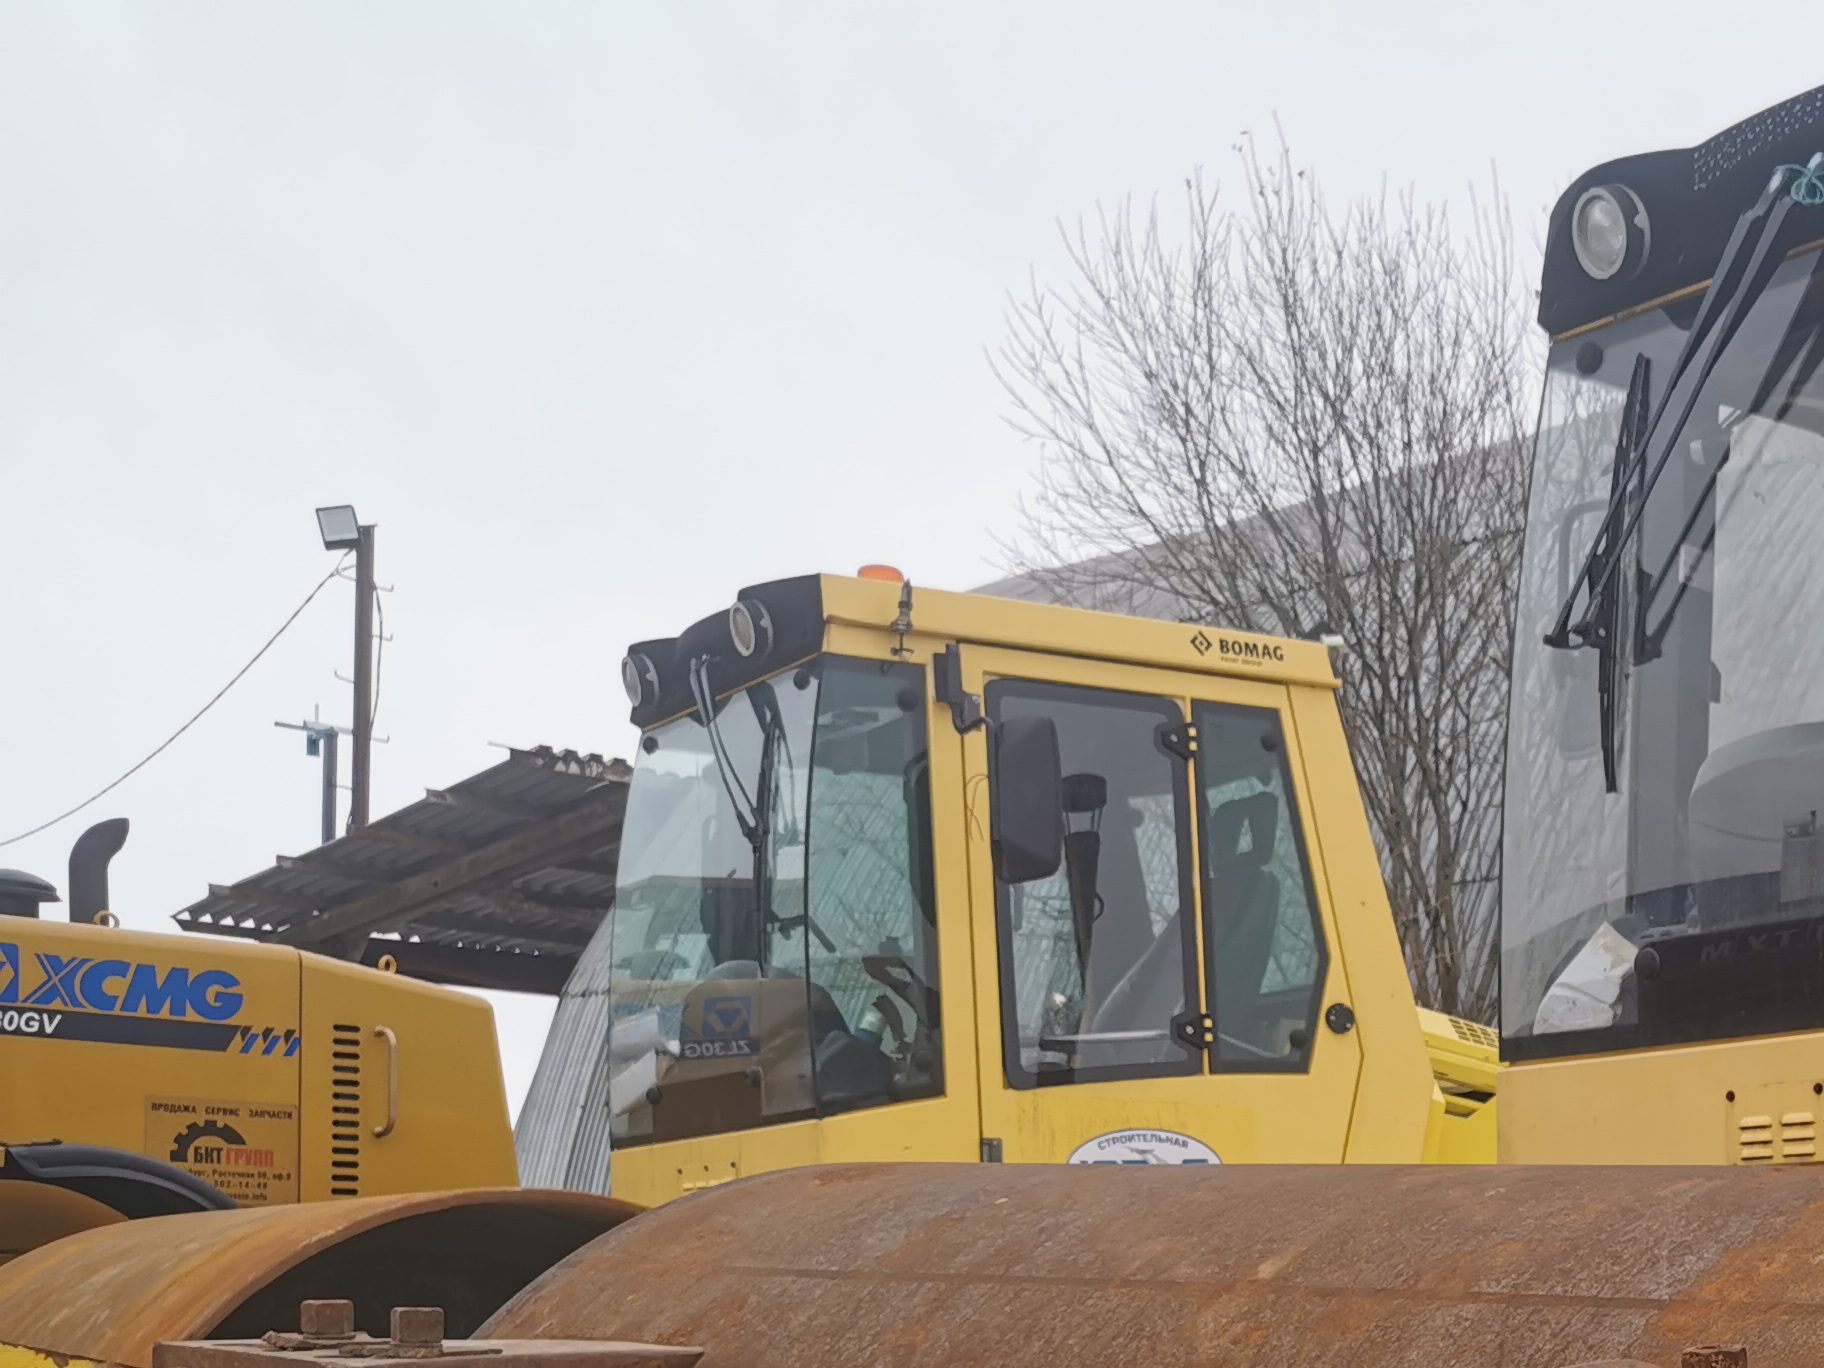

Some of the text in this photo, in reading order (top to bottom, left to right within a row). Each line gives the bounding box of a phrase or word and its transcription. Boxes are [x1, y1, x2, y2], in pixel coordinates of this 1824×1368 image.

[1219, 638, 1284, 662] BOMAG
[20, 952, 243, 1021] XCMG
[0, 1009, 62, 1034] 0GV
[151, 1102, 293, 1120] ПРОДАЖА СЕРВИС ЗАПЧАСТИ
[1097, 1133, 1189, 1150] СТРОИТЕЛЬНАЯ
[225, 1147, 275, 1168] ГРУПП
